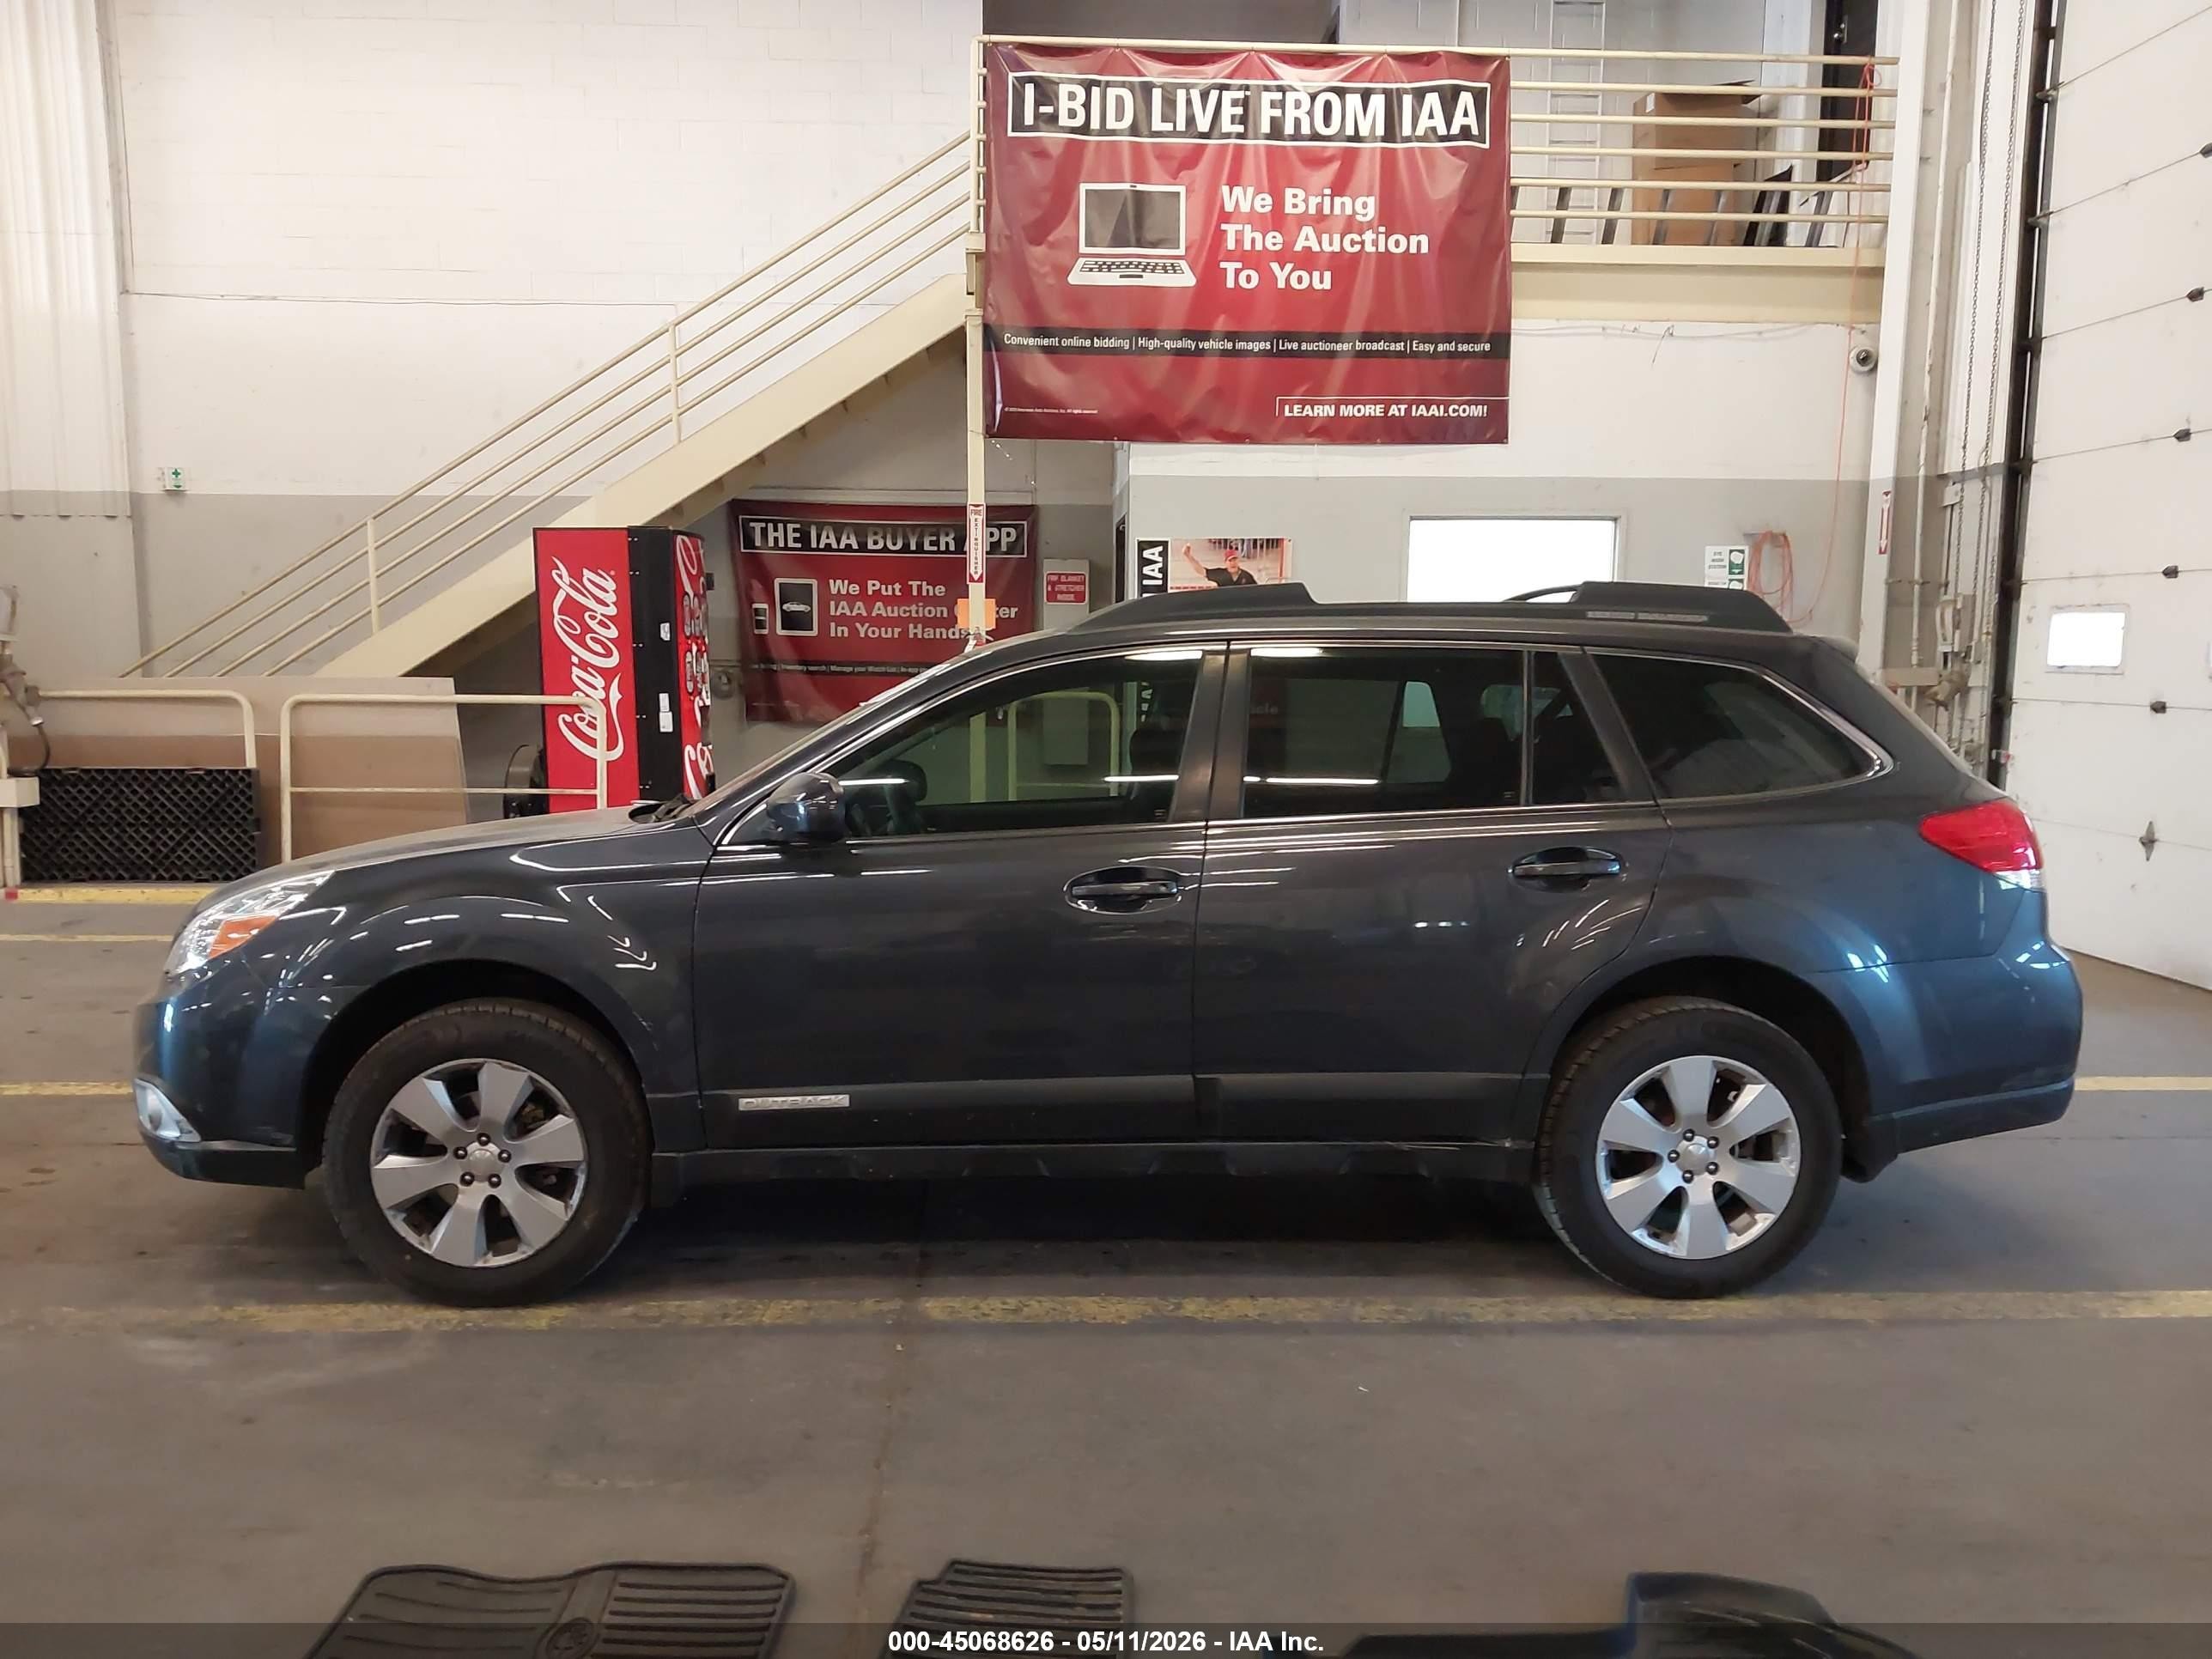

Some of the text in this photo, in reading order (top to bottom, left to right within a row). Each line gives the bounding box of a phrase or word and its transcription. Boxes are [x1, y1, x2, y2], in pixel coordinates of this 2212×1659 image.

[1024, 82, 1480, 137] I-BID LIVE FROM IAA
[1221, 185, 1376, 222] We Bring
[1220, 223, 1430, 254] The Auction
[1219, 261, 1332, 290] To You
[1003, 333, 1060, 348] Convenient
[1060, 335, 1091, 348] online
[1094, 335, 1130, 350] bidding
[1138, 336, 1197, 351] High-quality
[1198, 337, 1233, 350] vehicle
[1235, 338, 1271, 352] images
[1279, 338, 1298, 350] Live
[1300, 339, 1353, 352] auctioneer
[1355, 339, 1405, 352] broadcast
[1413, 340, 1435, 354] Easy
[1437, 341, 1455, 352] and
[1457, 342, 1491, 352] secure
[1284, 404, 1488, 417] LEARN MORE AT IAAI.COM!
[749, 521, 1017, 552] THE IAA BUYER PP
[1142, 545, 1164, 586] IAA
[829, 579, 946, 597] We Put The
[829, 600, 868, 617] IAA
[872, 602, 948, 618] Auction
[830, 622, 848, 638] In
[855, 623, 902, 639] Your
[742, 1095, 846, 1109] OUTBACK
